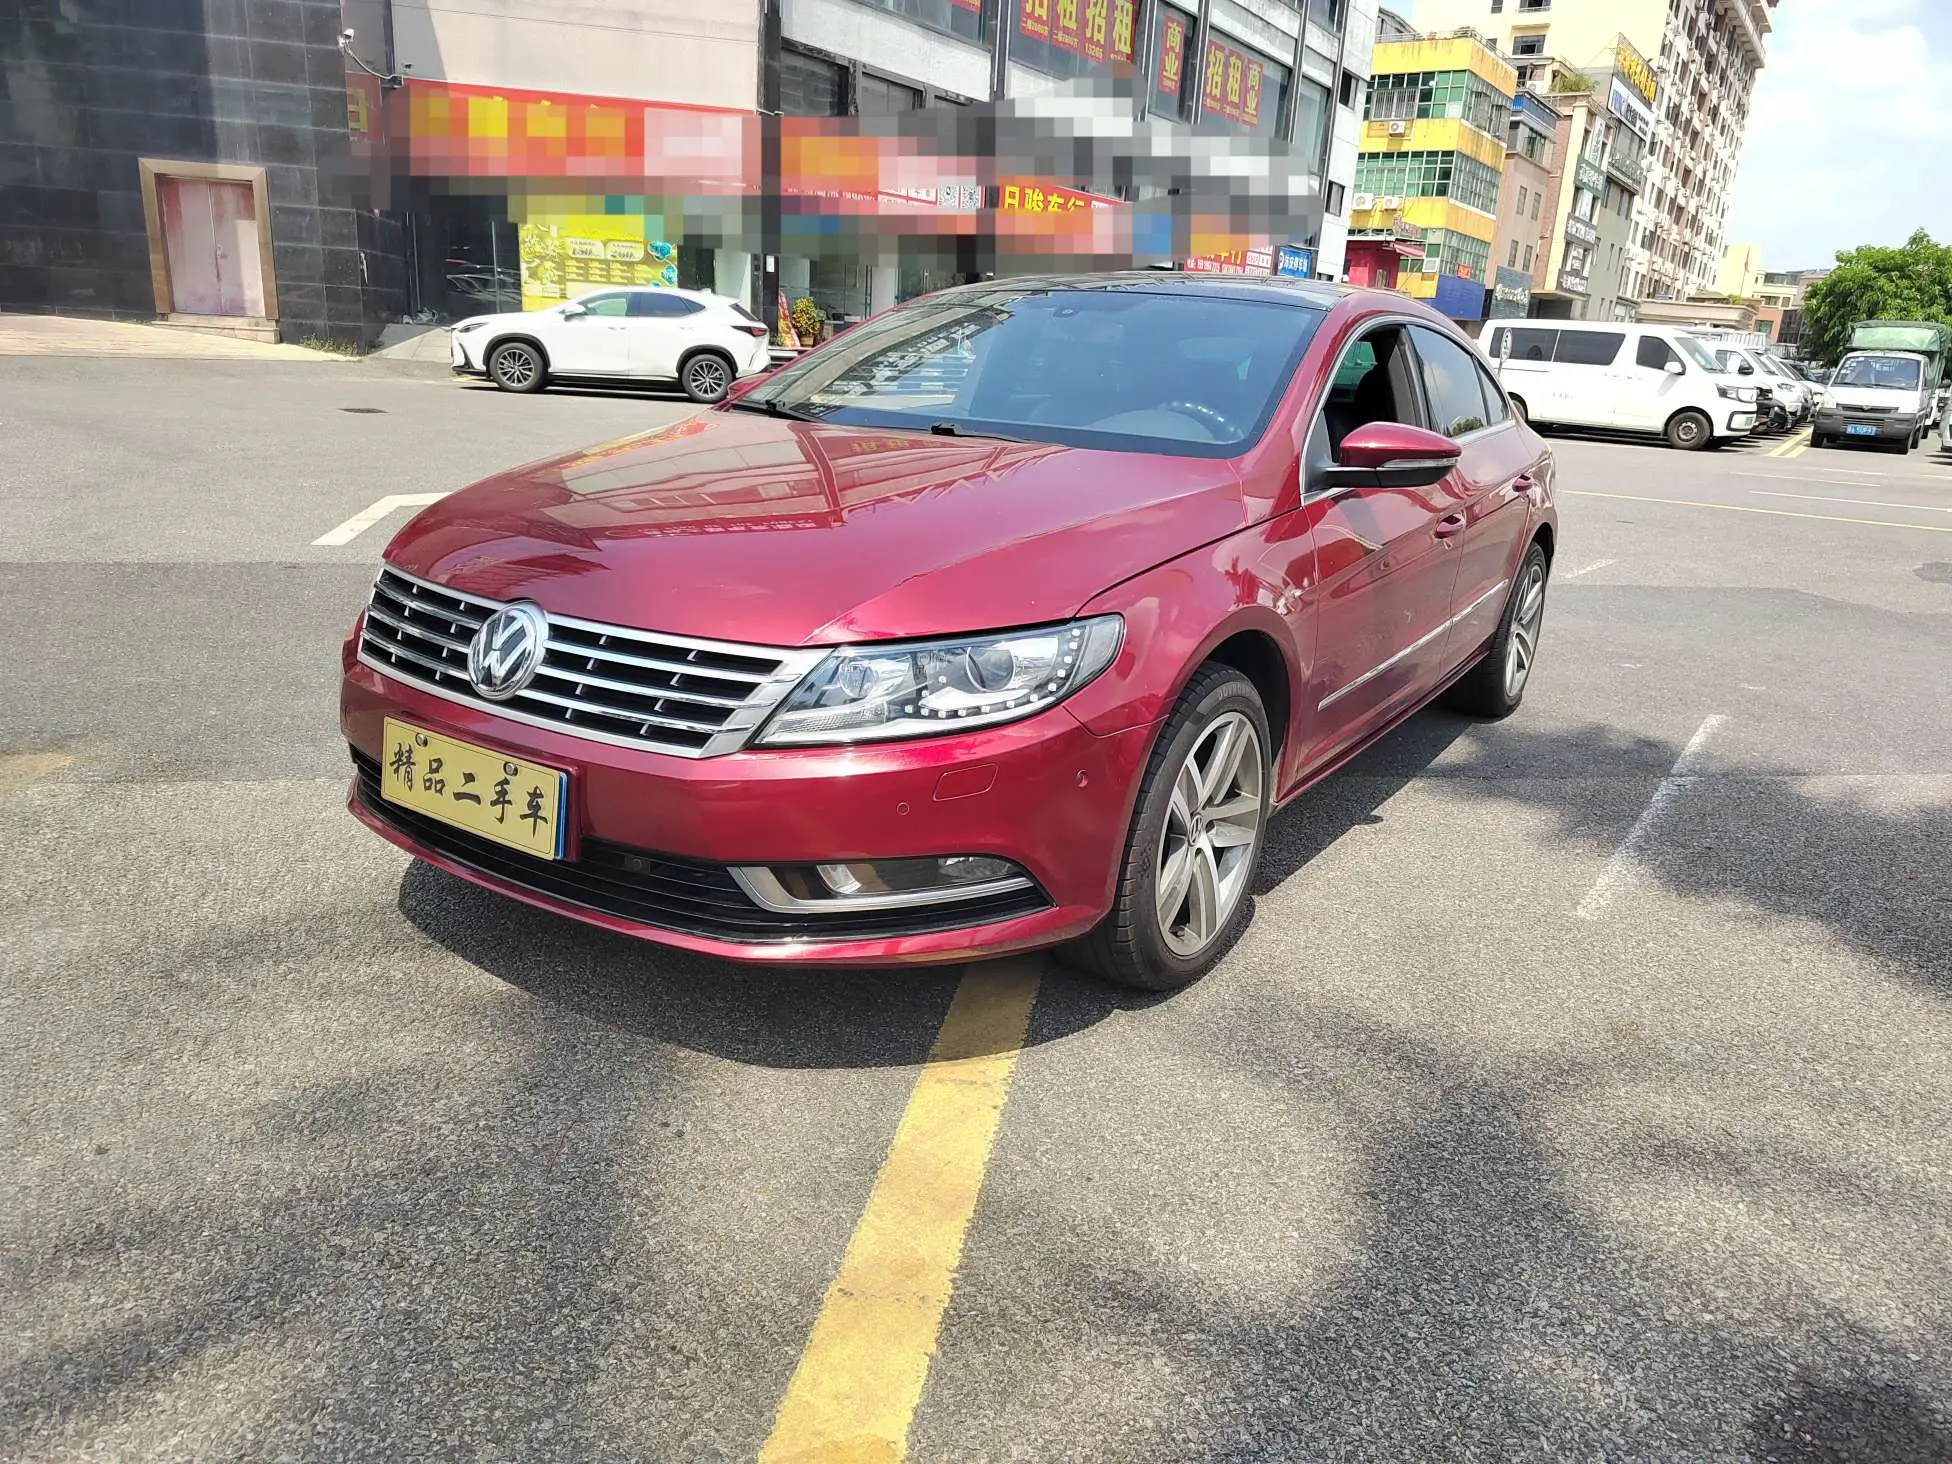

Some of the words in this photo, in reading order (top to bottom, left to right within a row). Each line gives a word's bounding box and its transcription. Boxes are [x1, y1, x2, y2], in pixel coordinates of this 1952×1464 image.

[1163, 22, 1182, 80] 商业
[1206, 45, 1241, 103] 招租
[1244, 63, 1261, 115] 商业
[389, 743, 548, 838] 精品二手车
